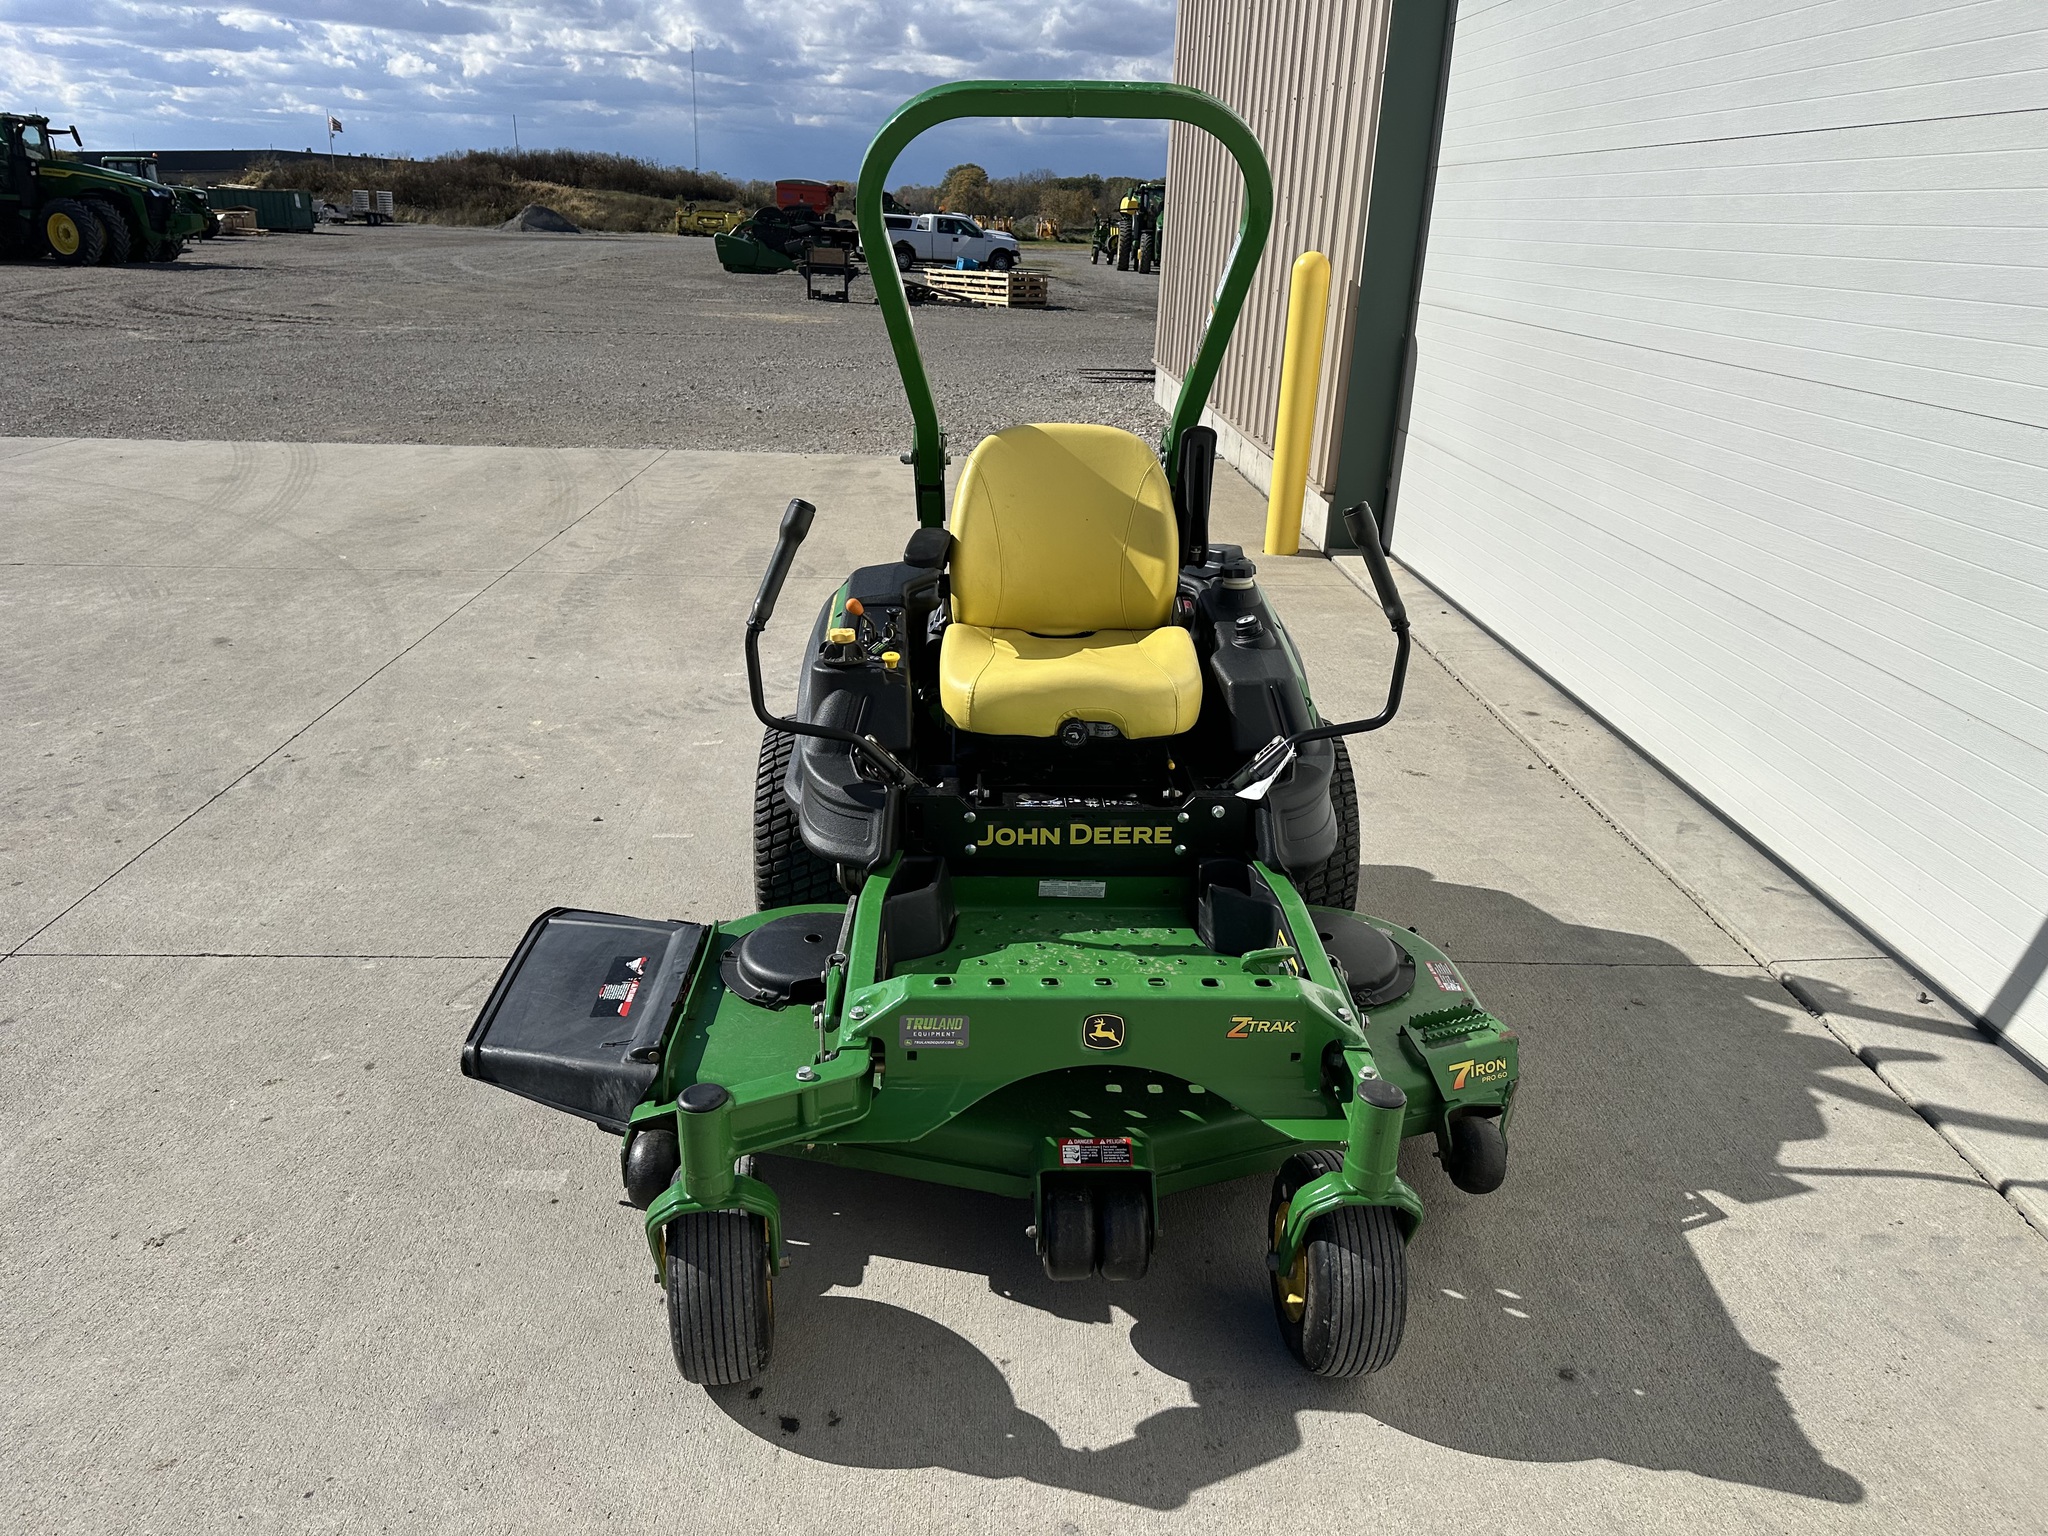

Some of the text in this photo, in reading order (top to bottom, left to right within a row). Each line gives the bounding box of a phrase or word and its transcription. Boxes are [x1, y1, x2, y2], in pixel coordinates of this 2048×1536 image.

[977, 823, 1173, 846] JOHN DEERE
[905, 1017, 964, 1030] TRULAND
[1481, 1071, 1508, 1083] PRO 60
